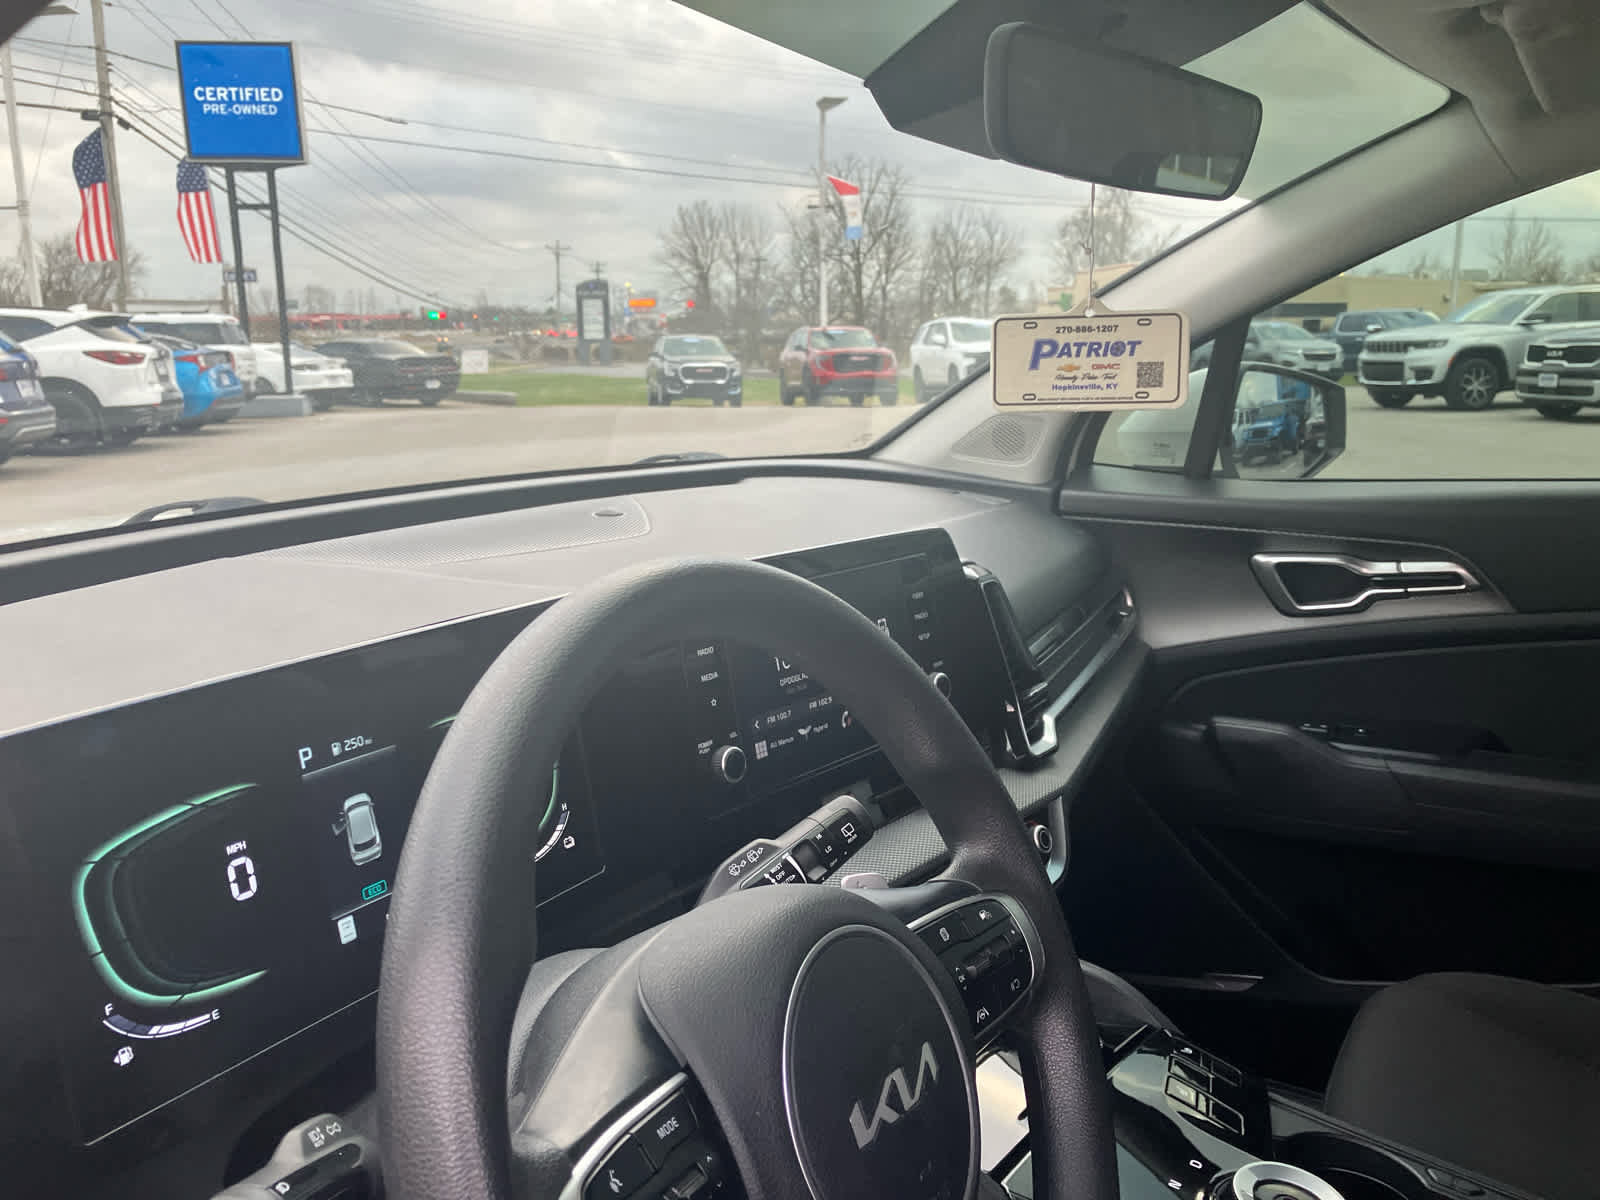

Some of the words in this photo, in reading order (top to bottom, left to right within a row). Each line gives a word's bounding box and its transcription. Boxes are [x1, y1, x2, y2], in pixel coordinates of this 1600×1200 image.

[193, 86, 283, 102] CERTIFIED
[203, 103, 278, 115] PRE-OWNED
[1028, 338, 1142, 371] PATRIOT
[697, 646, 714, 656] RADIO
[701, 671, 718, 682] MEDIA
[767, 715, 776, 724] FM
[344, 736, 365, 751] 250
[298, 747, 313, 770] P
[226, 840, 247, 855] MPH
[227, 856, 258, 901] 0
[367, 884, 382, 896] ECO
[104, 1003, 113, 1016] F
[211, 1008, 221, 1020] E
[656, 1116, 680, 1140] MODE
